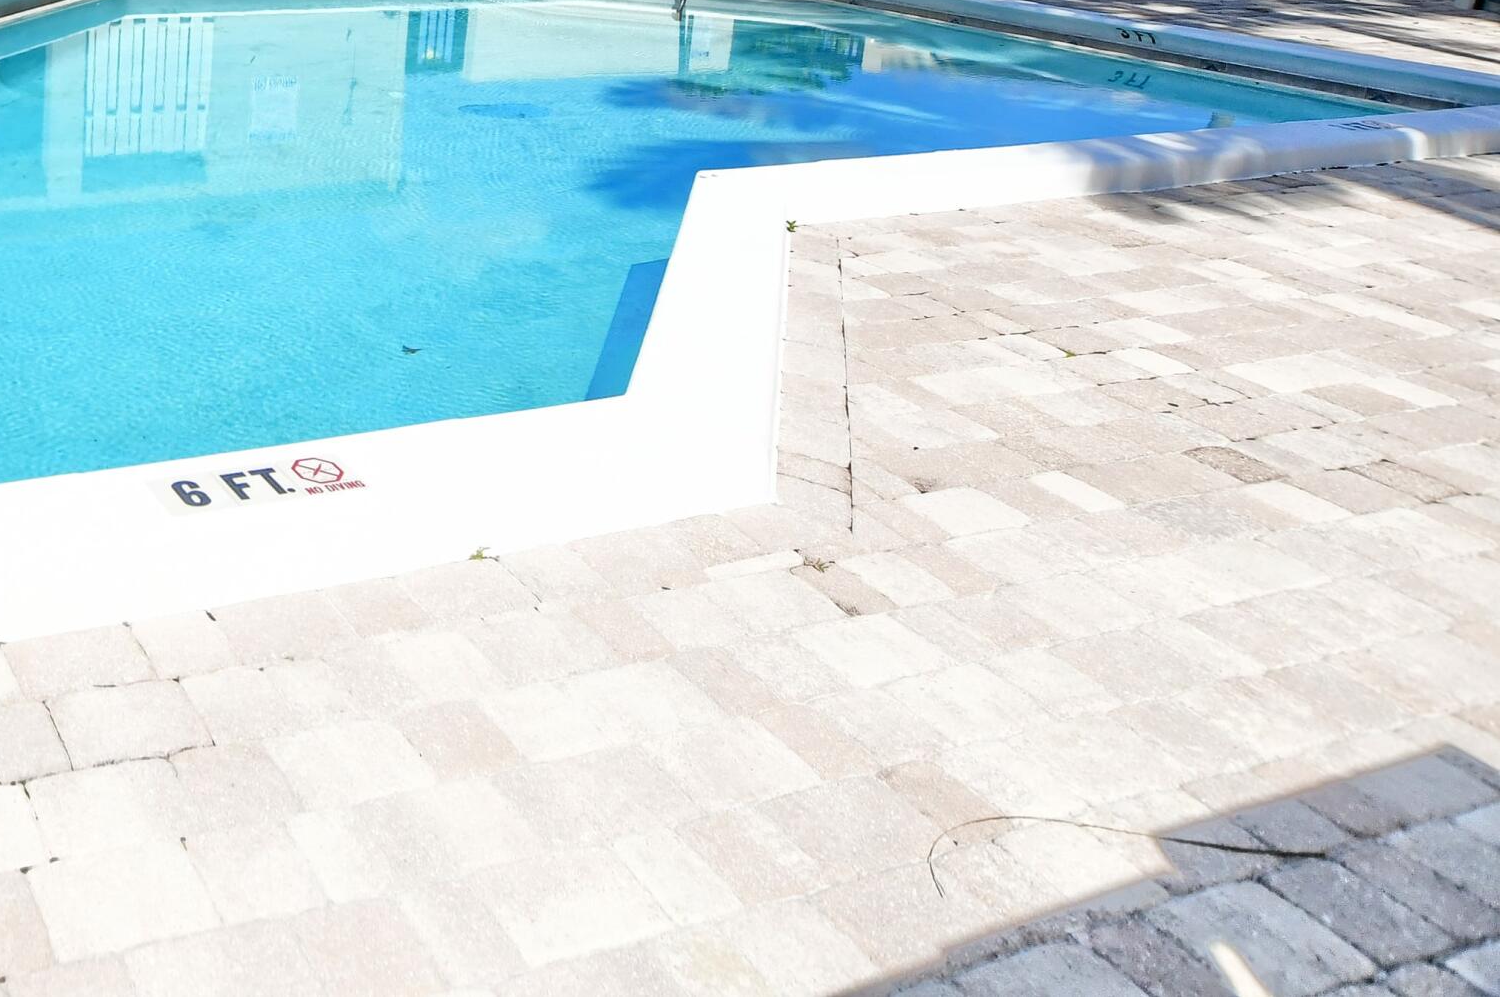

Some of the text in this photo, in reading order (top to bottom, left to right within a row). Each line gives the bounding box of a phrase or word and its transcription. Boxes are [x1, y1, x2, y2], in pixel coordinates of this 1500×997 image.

[171, 467, 296, 507] 6 FT.
[304, 480, 366, 495] NO DIVING
